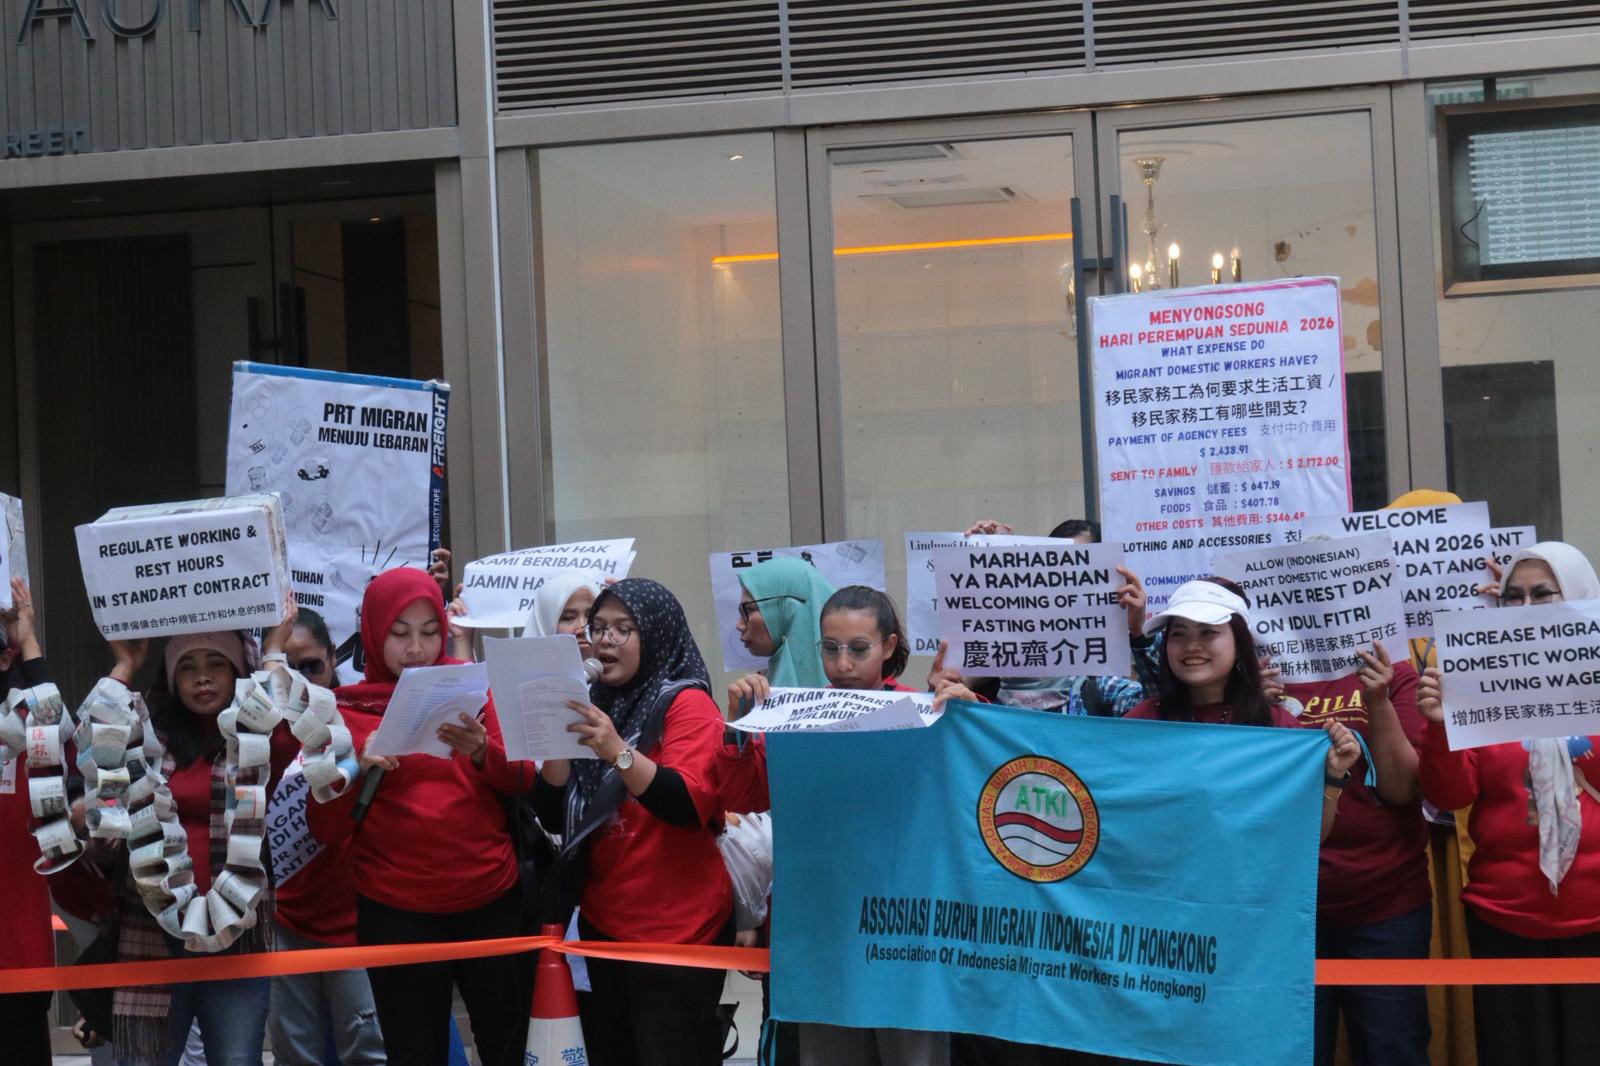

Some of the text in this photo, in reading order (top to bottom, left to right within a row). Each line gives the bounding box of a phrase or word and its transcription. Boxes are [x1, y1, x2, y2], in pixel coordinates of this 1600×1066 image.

[1149, 302, 1265, 325] MENYONGSONG
[1100, 317, 1334, 348] HARI PEREMPUAN SEDUNIA 2026
[1161, 339, 1265, 358] WHAT EXPENSE DO
[1116, 355, 1318, 380] MIGRANT DOMESTIC WORKERS HAVE?
[1105, 374, 1323, 405] 移民家務工為何要求生活工資
[323, 402, 428, 433] PRT MIGRAN
[318, 427, 428, 453] MENUJU LEBARAN
[1108, 433, 1157, 447] PAYMENT
[1161, 431, 1173, 442] OF
[1177, 428, 1218, 441] AGENCY
[1221, 426, 1248, 438] FEES
[1110, 469, 1138, 482] SENT
[1142, 468, 1155, 480] TO
[1158, 465, 1198, 479] FAMILY
[1154, 486, 1196, 498] SAVINGS
[1251, 480, 1281, 491] 647.19
[432, 488, 441, 542] SECURITY TAPE
[1160, 502, 1192, 514] FOODS
[1241, 497, 1280, 509] $407.78
[1135, 519, 1169, 532] OTHER
[1172, 518, 1204, 530] COSTS
[1341, 508, 1448, 532] WELCOME
[99, 525, 257, 558] REGULATE WORKING &
[572, 545, 610, 553] HAK
[1171, 539, 1194, 550] AND
[1198, 533, 1272, 548] ACCESSORIES
[1435, 533, 1484, 553] 2026
[135, 554, 224, 578] REST HOURS
[475, 557, 617, 574] KAMI BERIBADAH
[969, 550, 1090, 569] MARHABAN
[1245, 548, 1360, 573] ALLOW (INDONESIAN)
[1406, 557, 1487, 579] DATANG
[291, 570, 324, 585] TUHAN
[467, 575, 518, 589] JAMIN
[950, 569, 1110, 589] YA RAMADHAN
[1279, 571, 1327, 587] DOMESTIC
[1331, 559, 1390, 577] WORKERS
[92, 573, 270, 609] IN STANDART CONTRACT
[944, 594, 1050, 610] WELCOMING
[1054, 594, 1079, 608] OF
[1083, 591, 1119, 606] THE
[1256, 572, 1392, 609] HAVE REST DAY
[1435, 583, 1479, 601] 2026
[962, 616, 1106, 633] FASTING MONTH
[1256, 605, 1371, 634] ON IDUL FITRI
[1446, 627, 1536, 648] INCREASE
[963, 636, 1108, 668] 慶祝齋介月
[1443, 652, 1540, 673] DOMESTIC
[1480, 676, 1542, 693] LIVING
[761, 691, 825, 711] HENTIKAN
[1015, 784, 1067, 817] ATKI
[859, 896, 1217, 975] ASSOSIASI BURUH MIGRAN INDONESIA DI HONGKONG
[866, 942, 1206, 1004] (Association Of Indonesia Migrant Workers In Hongkong)
